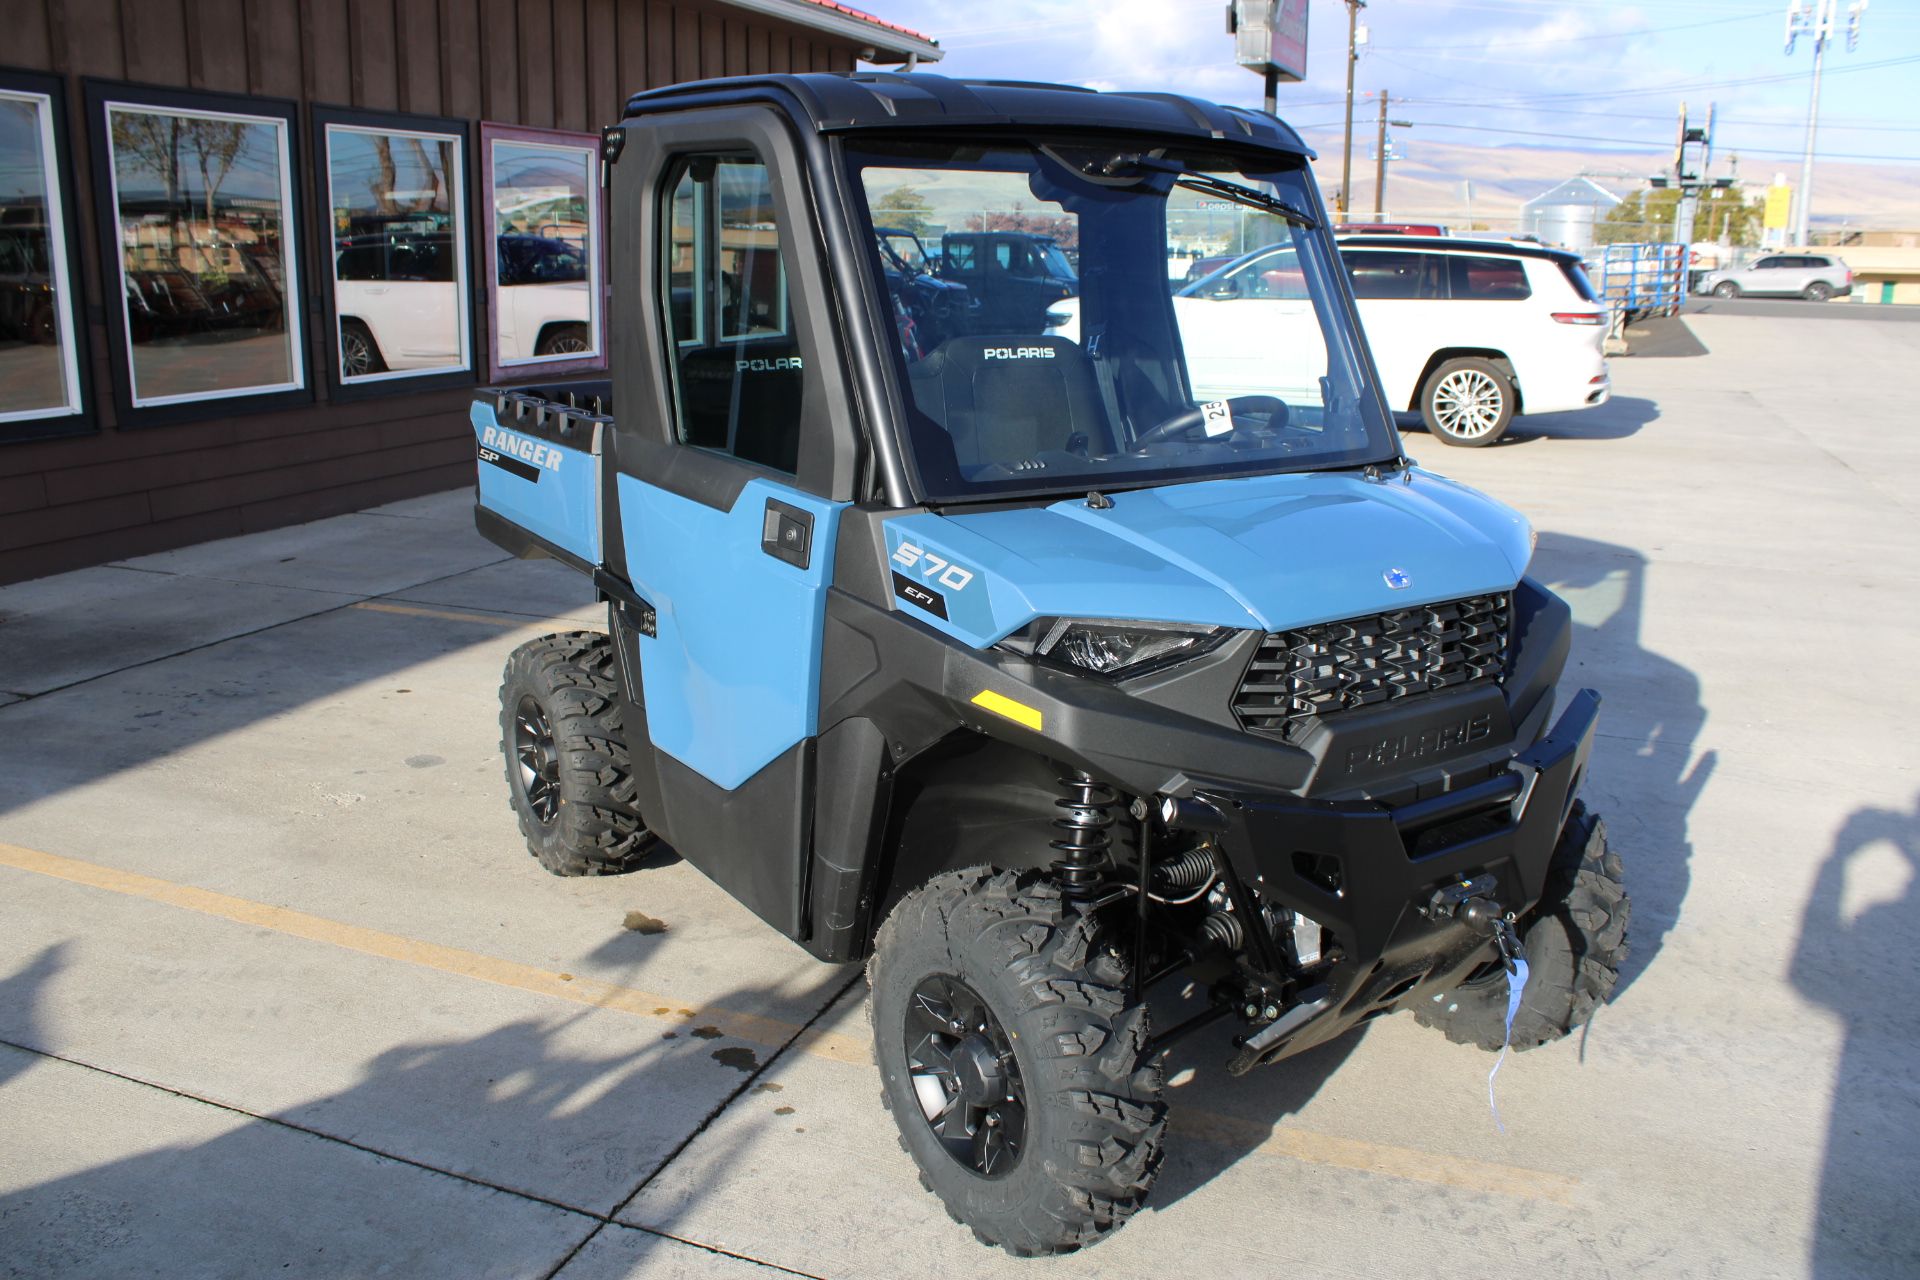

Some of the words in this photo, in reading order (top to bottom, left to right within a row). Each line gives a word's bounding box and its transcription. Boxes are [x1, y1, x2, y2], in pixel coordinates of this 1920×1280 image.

[984, 347, 1056, 360] POLARIS
[735, 357, 803, 372] POLAR
[479, 448, 500, 462] SP
[482, 426, 564, 472] RANGER
[892, 541, 974, 592] 570
[904, 586, 934, 605] EFI
[1345, 713, 1491, 774] POLARIS
